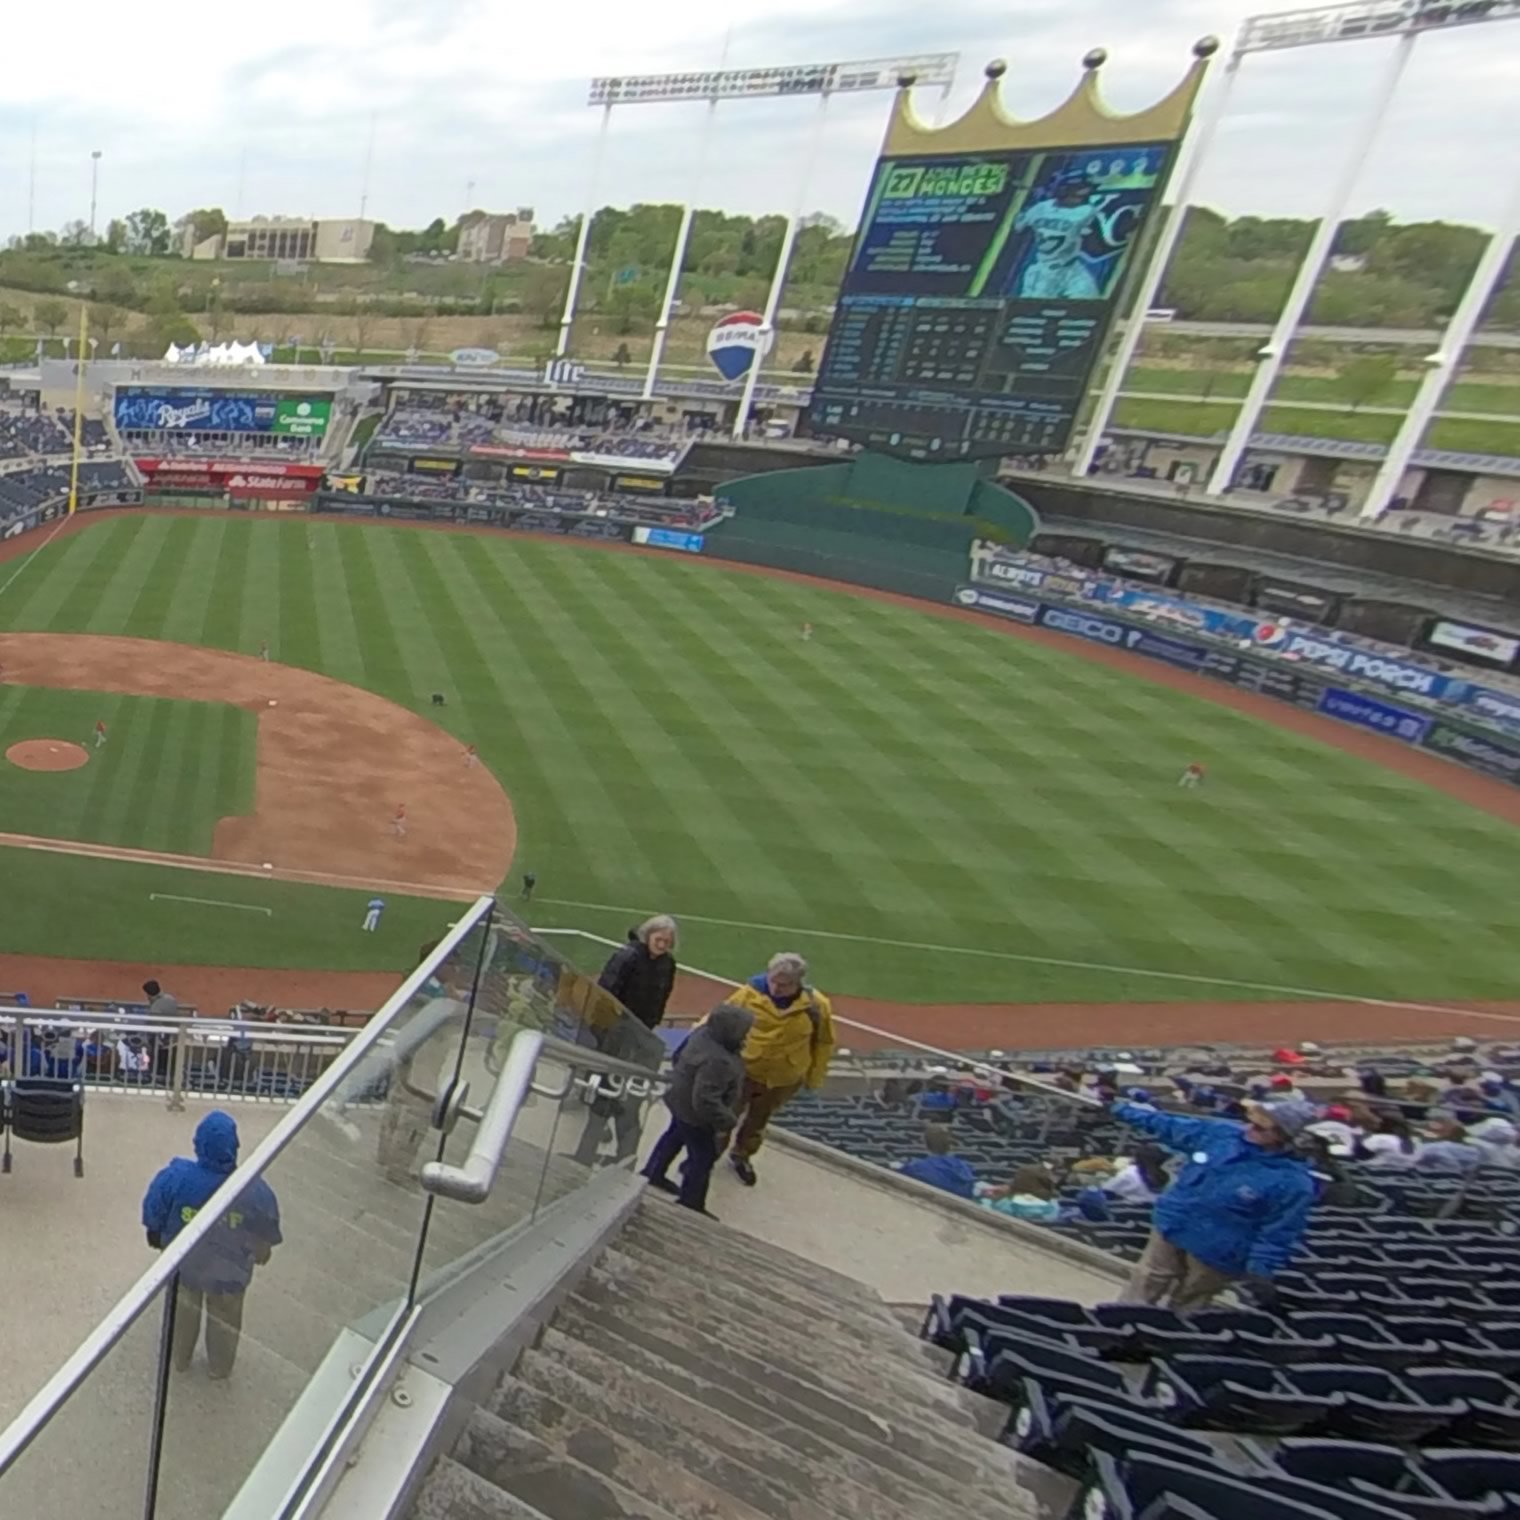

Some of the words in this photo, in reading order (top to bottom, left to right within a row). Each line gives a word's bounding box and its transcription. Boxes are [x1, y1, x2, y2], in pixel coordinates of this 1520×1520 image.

[716, 330, 759, 343] RE/MA
[157, 398, 211, 428] Royals
[246, 475, 277, 489] State
[276, 476, 306, 489] Farm
[1042, 609, 1123, 643] GEICO
[1289, 636, 1352, 668] PEPSI
[1347, 654, 1435, 693] PORCH
